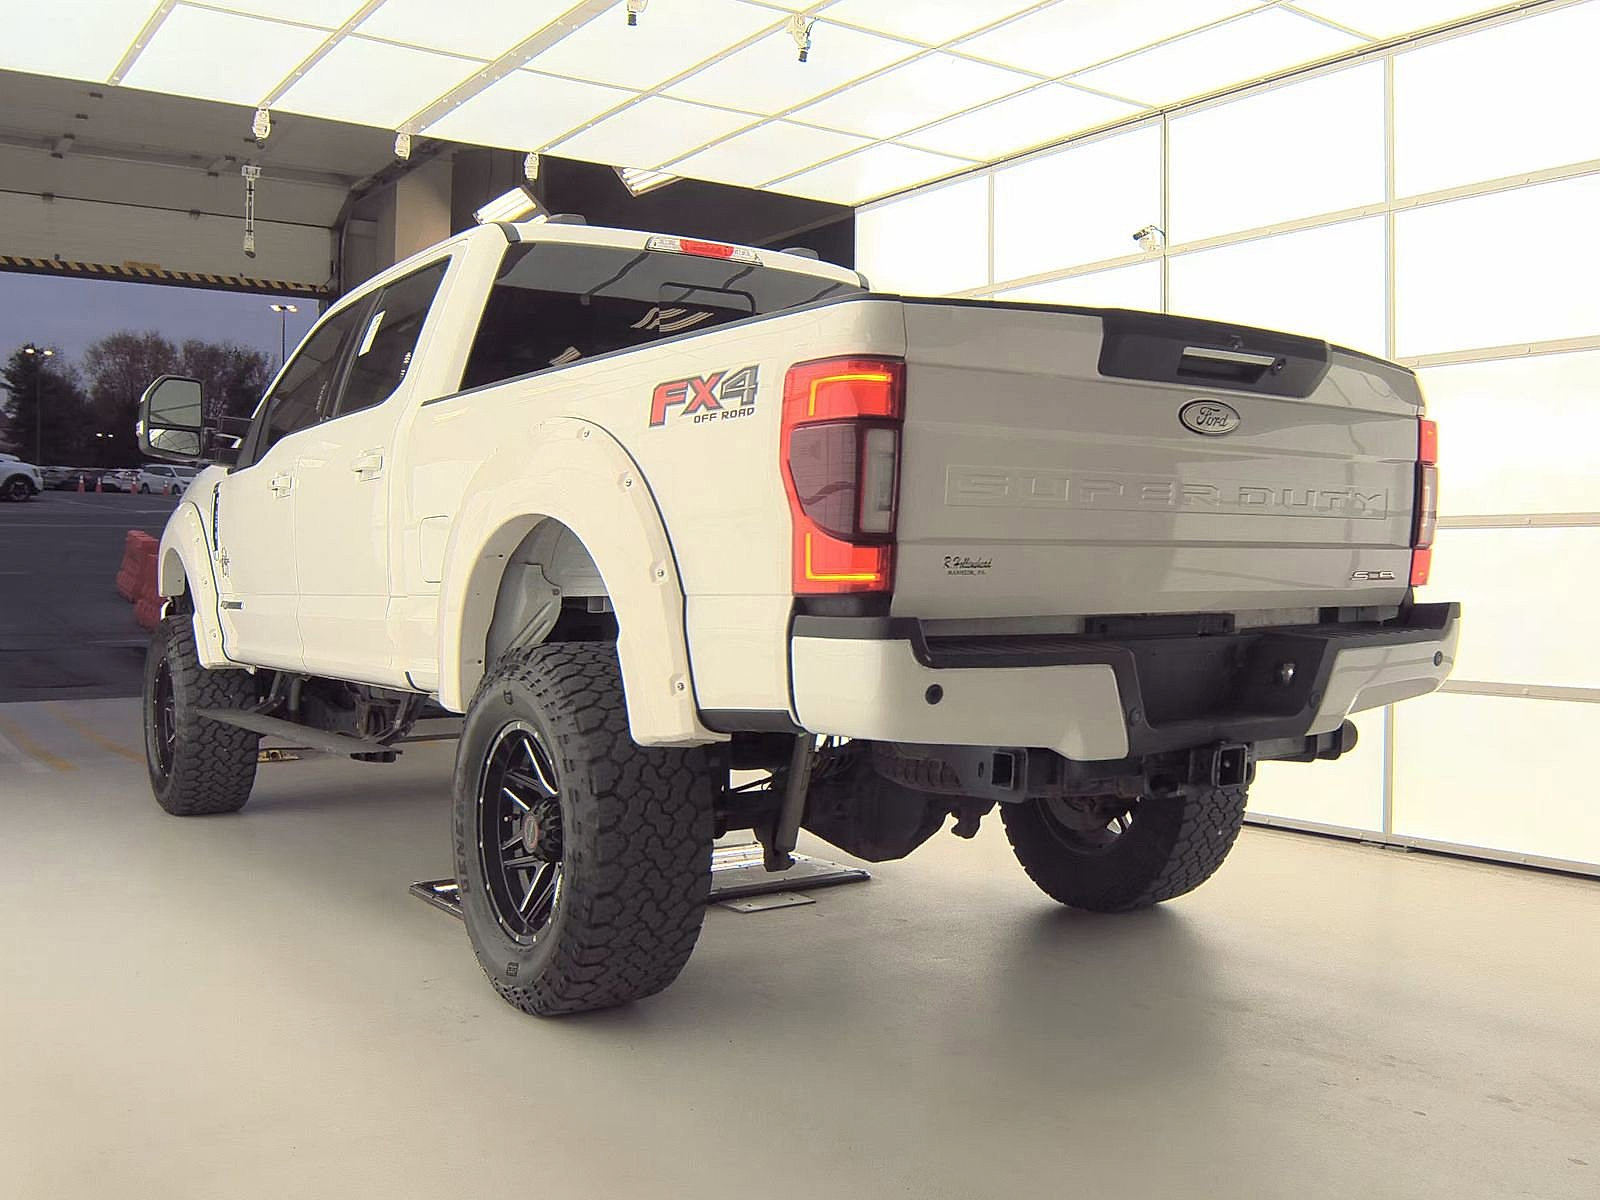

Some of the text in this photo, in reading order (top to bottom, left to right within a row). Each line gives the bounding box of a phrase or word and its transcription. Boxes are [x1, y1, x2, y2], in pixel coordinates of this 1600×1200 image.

[648, 363, 760, 427] FX4
[693, 407, 755, 424] OFF ROAD
[957, 473, 1383, 514] SUPER DUTY
